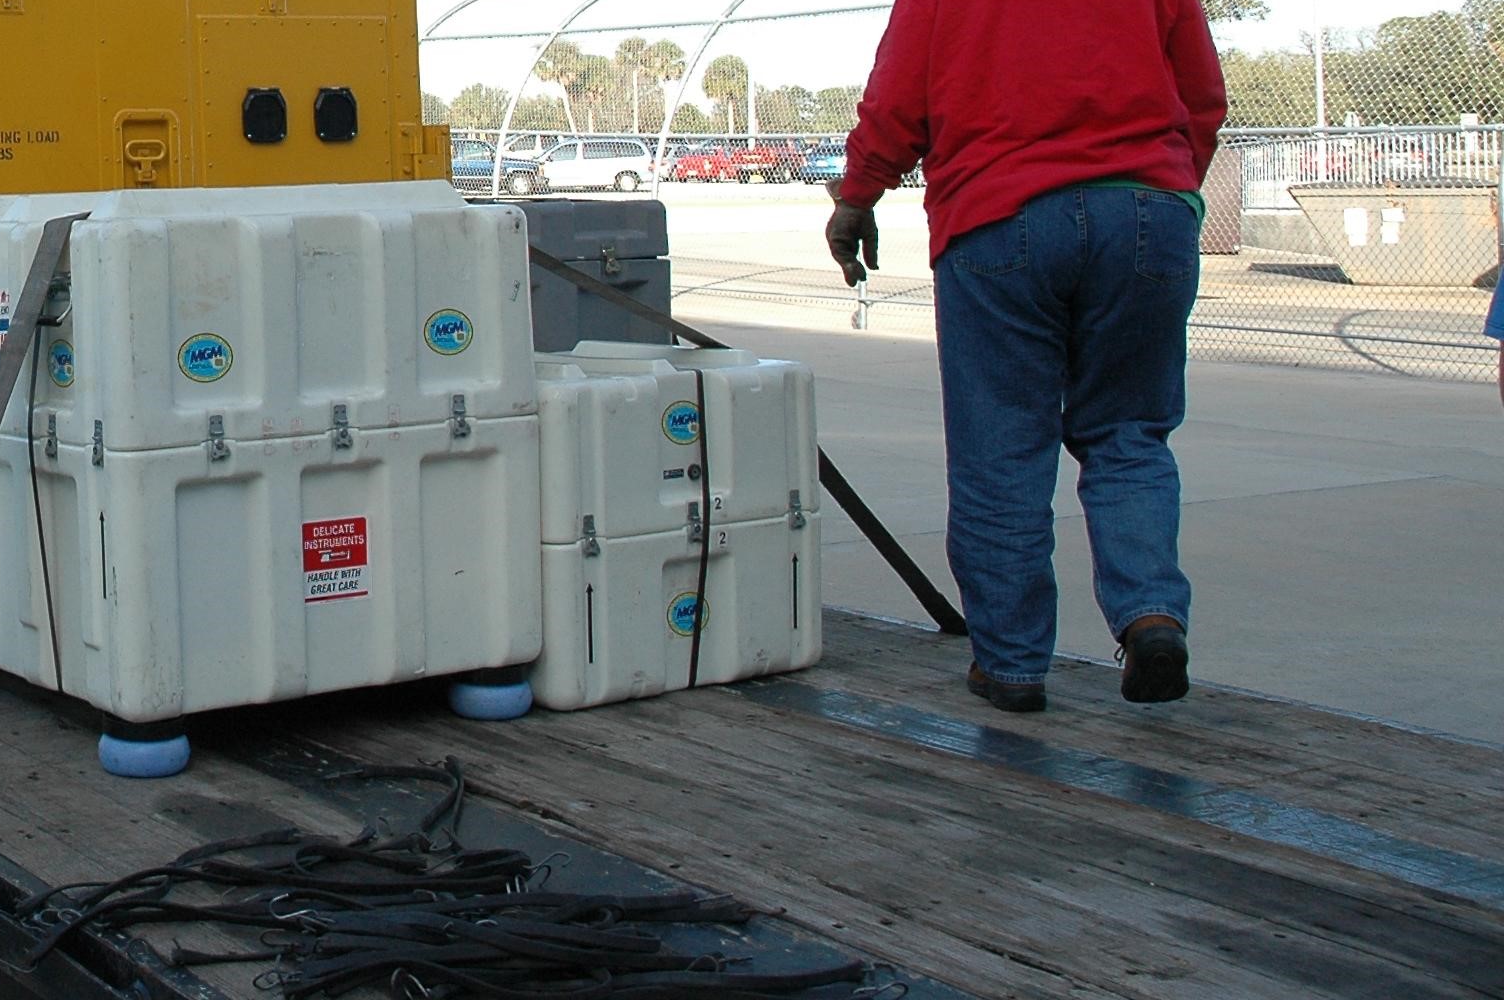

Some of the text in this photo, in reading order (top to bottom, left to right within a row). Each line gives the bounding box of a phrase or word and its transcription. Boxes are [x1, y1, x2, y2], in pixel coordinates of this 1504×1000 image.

[27, 131, 60, 143] LOAD
[434, 320, 465, 338] MGM
[188, 344, 223, 367] MGM
[671, 413, 698, 427] MGM
[714, 497, 722, 510] 2
[313, 523, 355, 537] DELICATE
[304, 534, 365, 550] INSTRUMENTS
[719, 532, 726, 544] 2
[307, 568, 362, 583] HANDLE WITH
[310, 580, 359, 595] GREAT CARE
